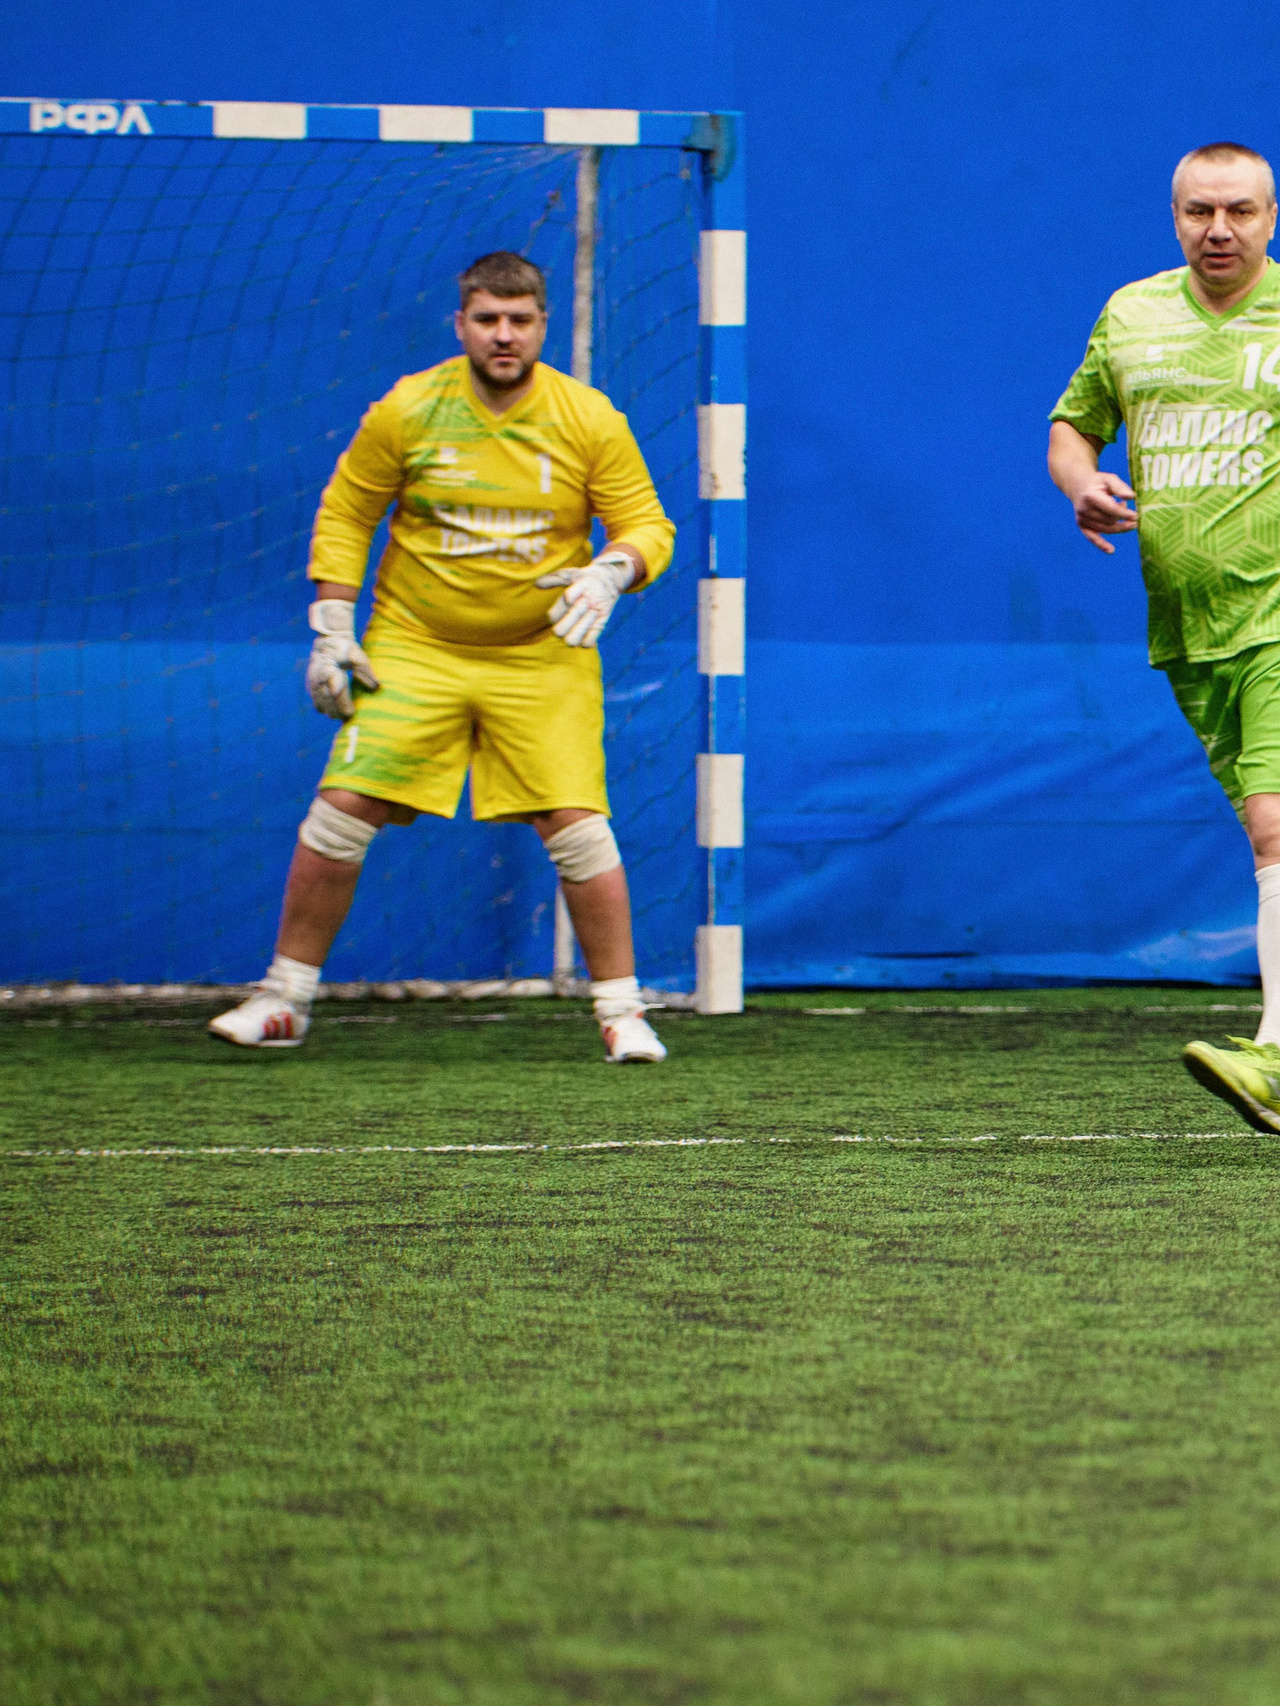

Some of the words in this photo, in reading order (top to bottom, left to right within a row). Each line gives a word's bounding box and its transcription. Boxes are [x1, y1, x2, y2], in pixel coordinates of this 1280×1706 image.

[29, 101, 154, 135] РФЛ
[1139, 409, 1273, 448] БАЛАНС
[538, 452, 552, 494] 1
[1141, 450, 1265, 491] TOWERS
[345, 727, 358, 762] 1
